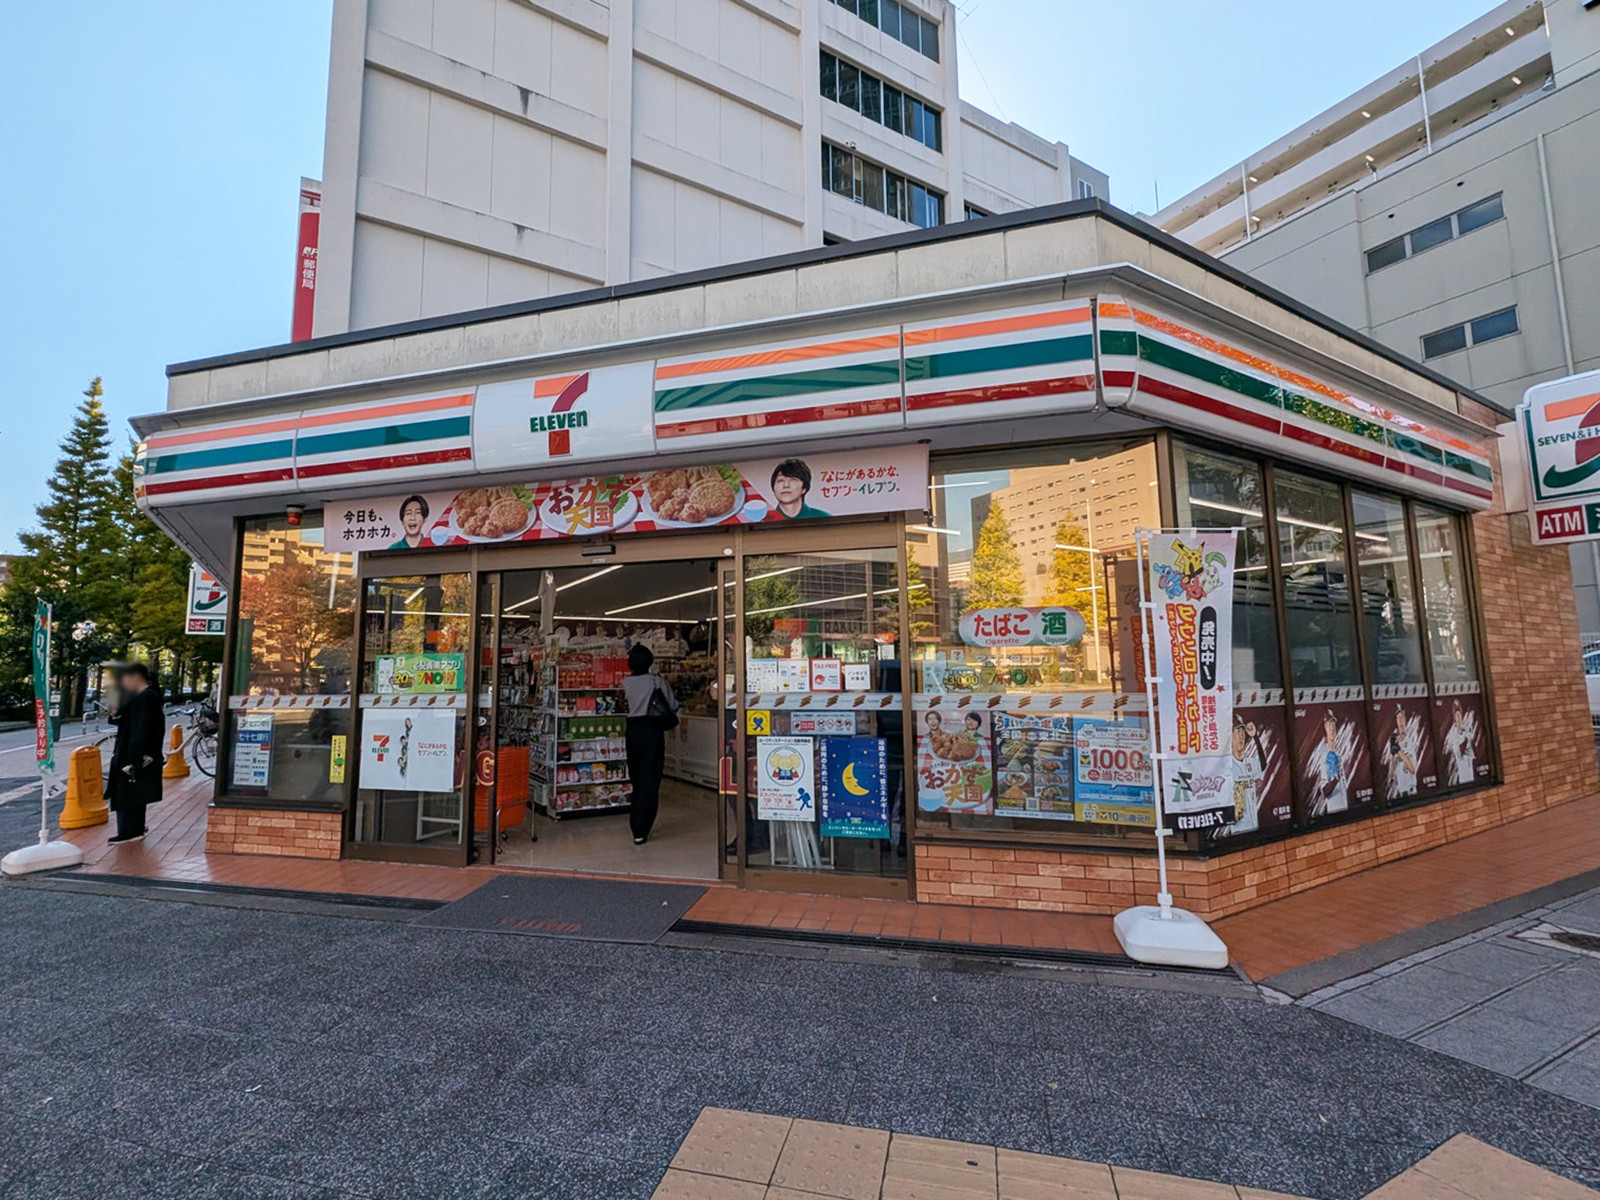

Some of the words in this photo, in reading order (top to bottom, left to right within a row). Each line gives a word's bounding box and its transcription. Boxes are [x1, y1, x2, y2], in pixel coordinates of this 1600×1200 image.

[302, 259, 315, 290] 郵便局
[343, 508, 383, 525] 今日も、
[563, 500, 614, 534] 天国
[1540, 510, 1582, 536] ATM
[342, 525, 397, 541] ホカホカ。
[974, 613, 1030, 637] たばこ
[1042, 611, 1068, 636] 酒
[985, 637, 1020, 645] cigarette
[1045, 636, 1069, 644] liquor
[416, 672, 456, 685] 7NOW
[943, 784, 983, 806] 天国
